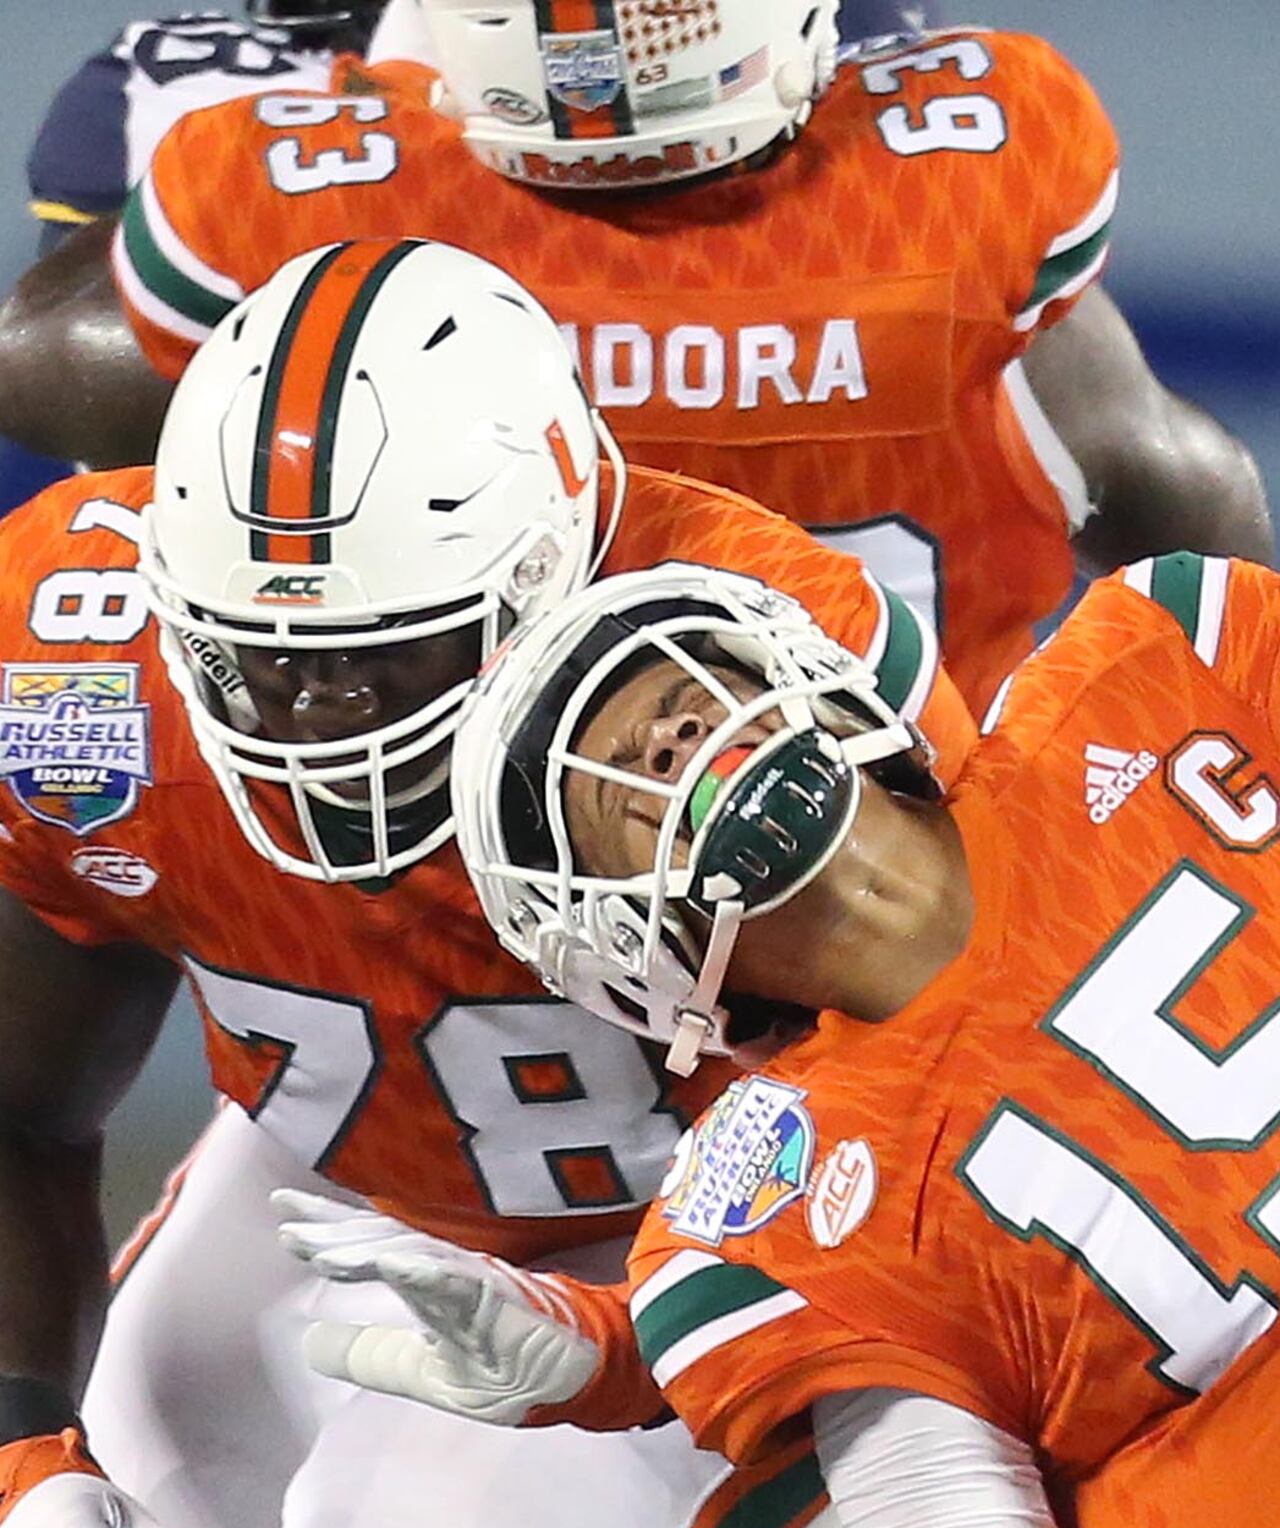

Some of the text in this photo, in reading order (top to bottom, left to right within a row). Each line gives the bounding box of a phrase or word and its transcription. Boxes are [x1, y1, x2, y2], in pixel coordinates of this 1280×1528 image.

[636, 63, 669, 85] 63
[861, 39, 1008, 157] 63
[255, 95, 399, 195] 63
[257, 575, 326, 597] ACC
[182, 628, 247, 695] iddell
[0, 722, 139, 742] RUSSELL
[3, 744, 140, 761] ATHLETIC
[32, 767, 114, 783] BOWL
[1089, 750, 1158, 824] adidas
[181, 952, 686, 1218] 78
[822, 1150, 863, 1230] ACC
